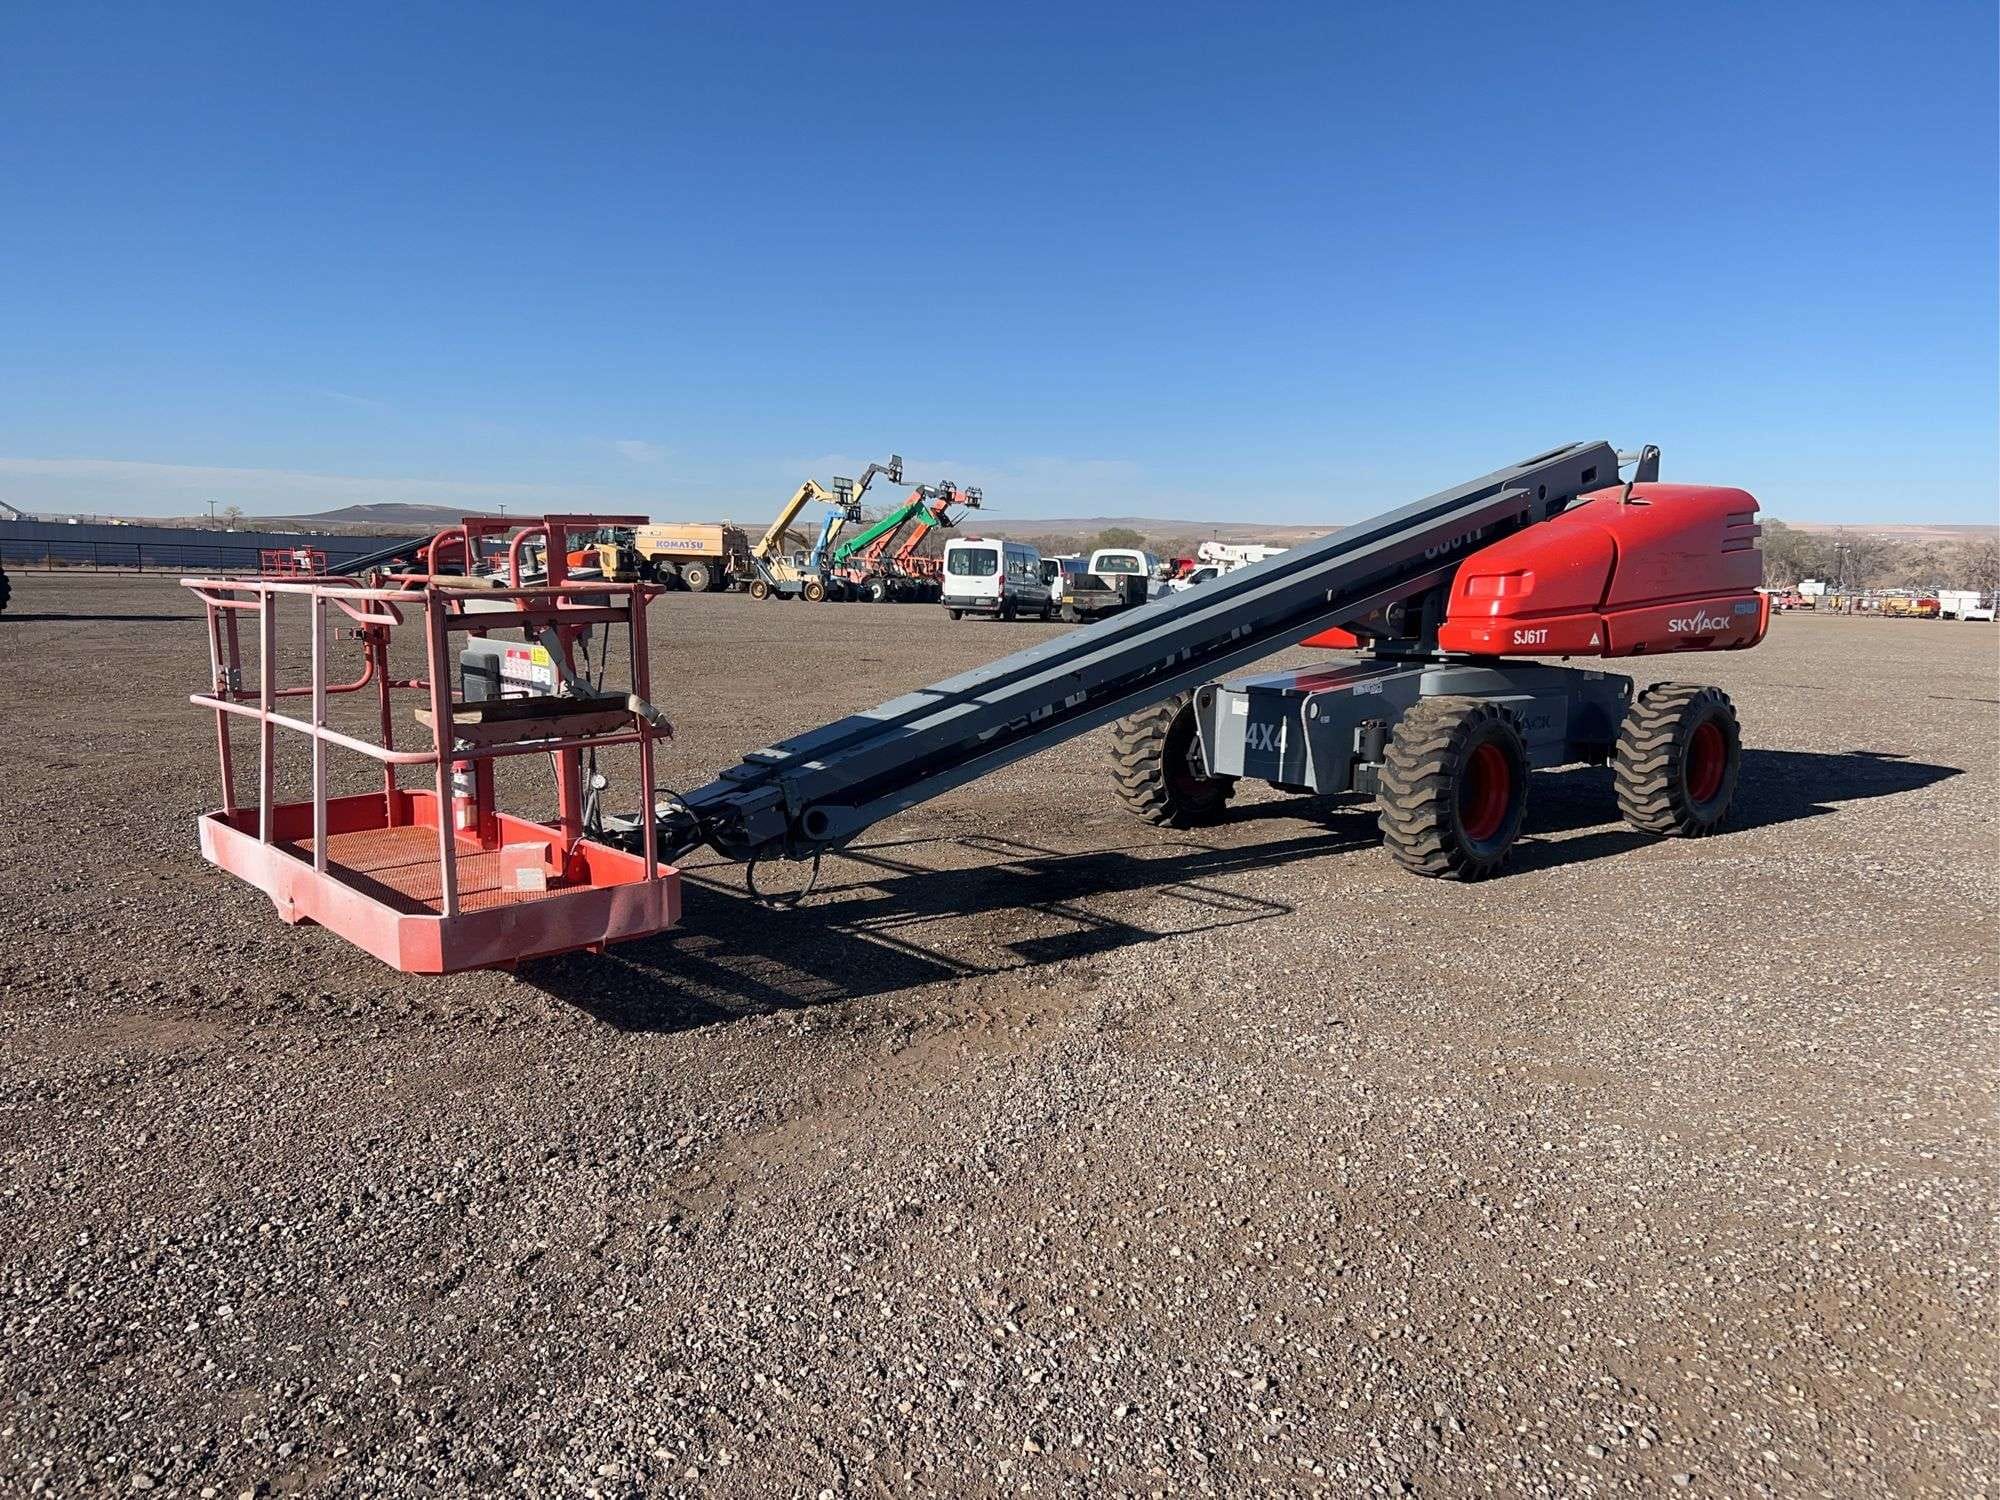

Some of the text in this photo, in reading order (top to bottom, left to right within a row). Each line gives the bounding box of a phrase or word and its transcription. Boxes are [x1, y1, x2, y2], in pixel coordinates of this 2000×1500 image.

[656, 540, 704, 549] KOMATSU
[1668, 609, 1730, 635] SKYJACK
[1513, 629, 1548, 645] SJ61T
